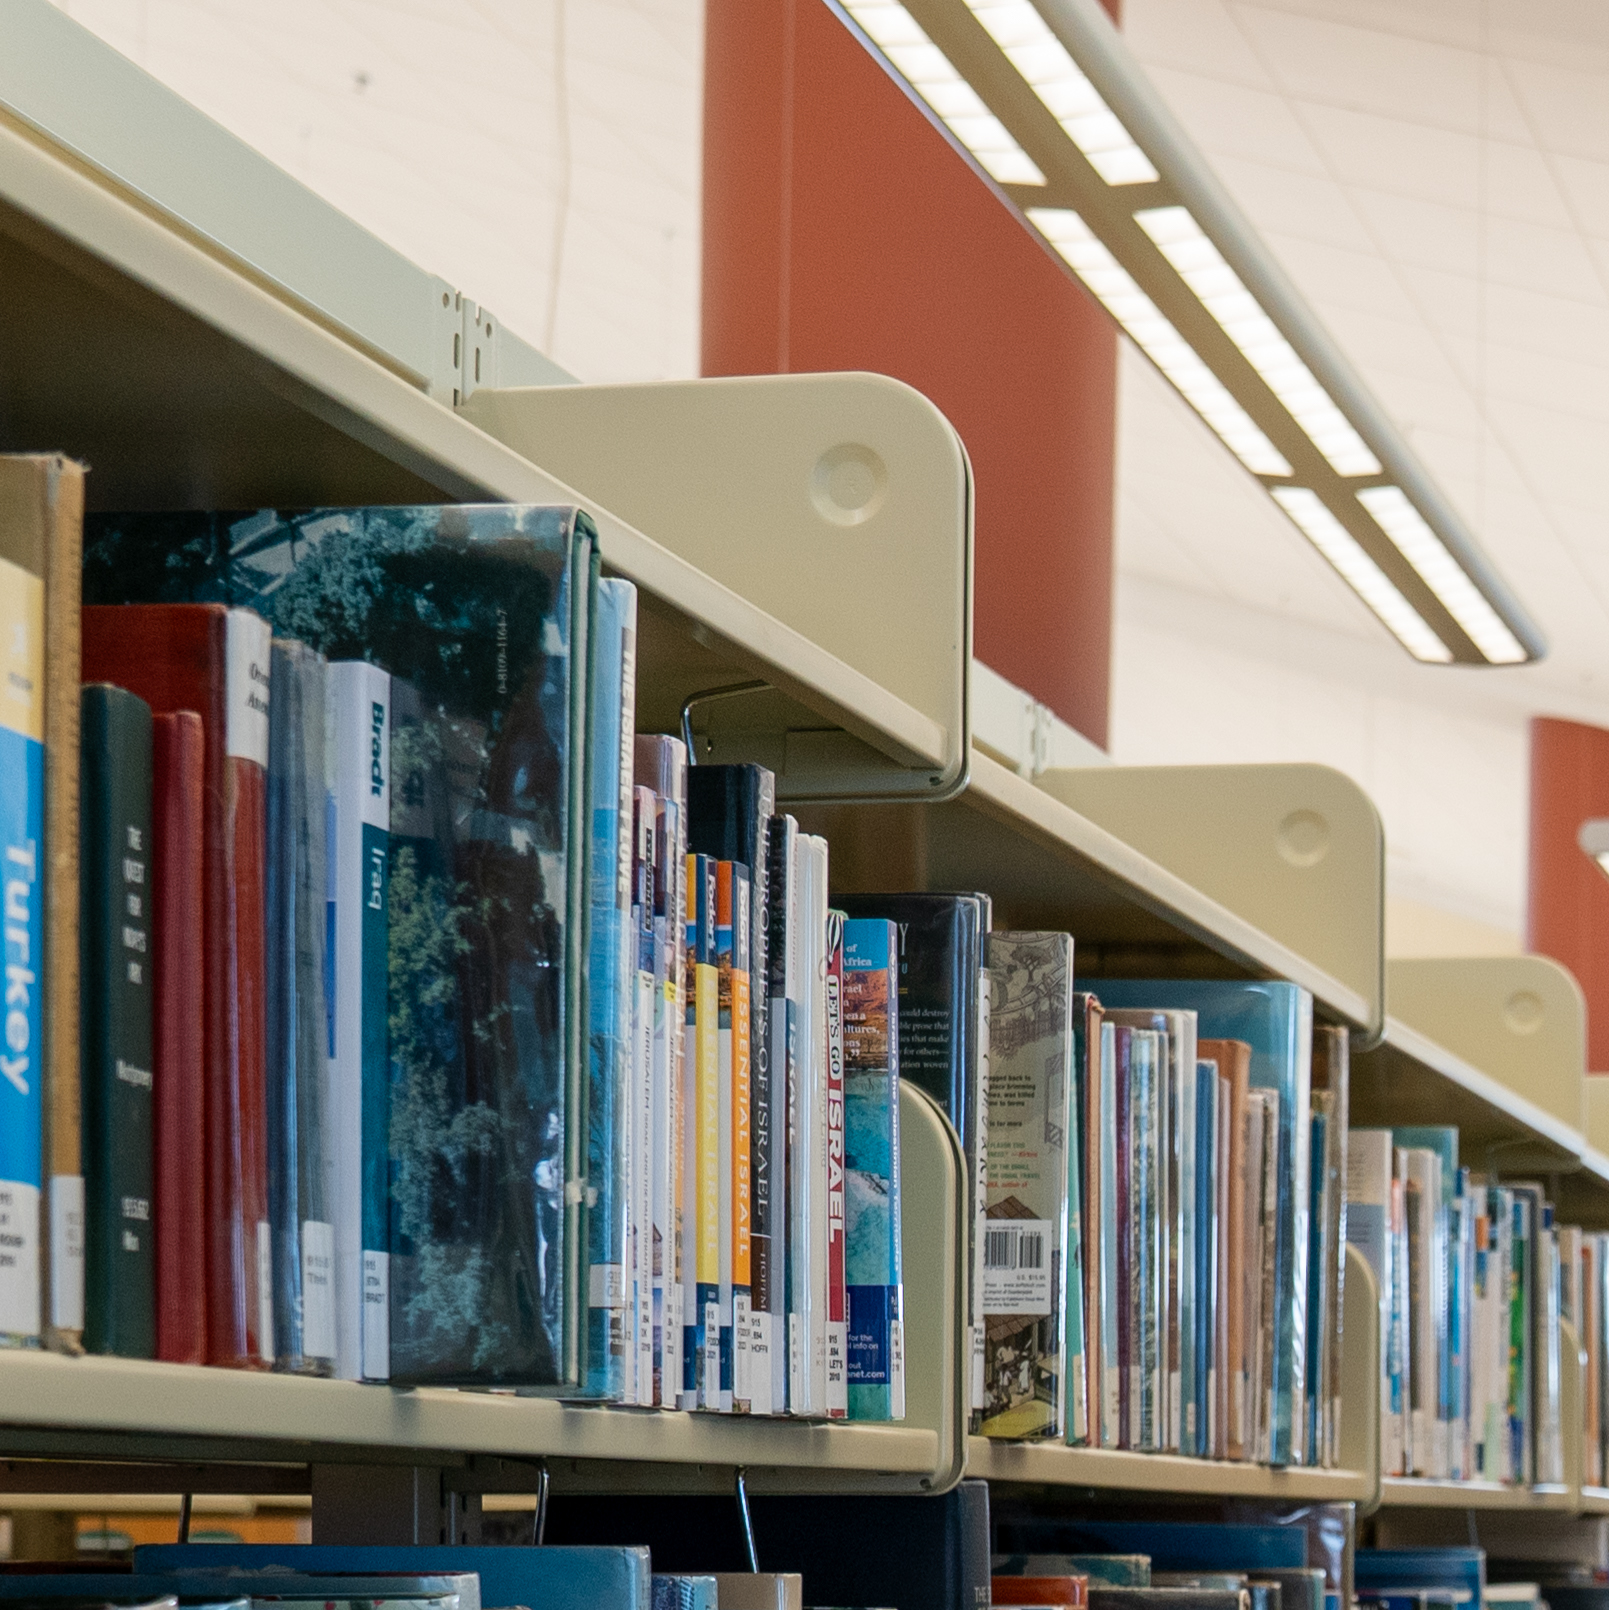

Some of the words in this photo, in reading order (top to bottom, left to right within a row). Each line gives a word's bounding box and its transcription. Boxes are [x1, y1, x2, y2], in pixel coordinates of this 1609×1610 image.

[621, 650, 636, 698] THE
[619, 707, 635, 801] ISRAEL
[618, 836, 633, 894] LOVE
[760, 792, 773, 849] THE
[366, 847, 384, 911] Iraq
[645, 832, 654, 927] EYEWITNESS
[0, 838, 37, 1097] Turkey
[757, 868, 771, 1037] PROPHETS
[828, 980, 841, 1039] LET'S
[706, 979, 718, 1138] ESSENTIAL
[739, 985, 749, 1143] ESSENTIAL
[757, 1046, 769, 1090] OF
[829, 1045, 841, 1076] GO
[706, 1152, 718, 1253] ISRAEL
[756, 1096, 769, 1216] ISRAEL
[828, 1087, 844, 1243] ISRAEL
[739, 1154, 749, 1256] ISRAEL
